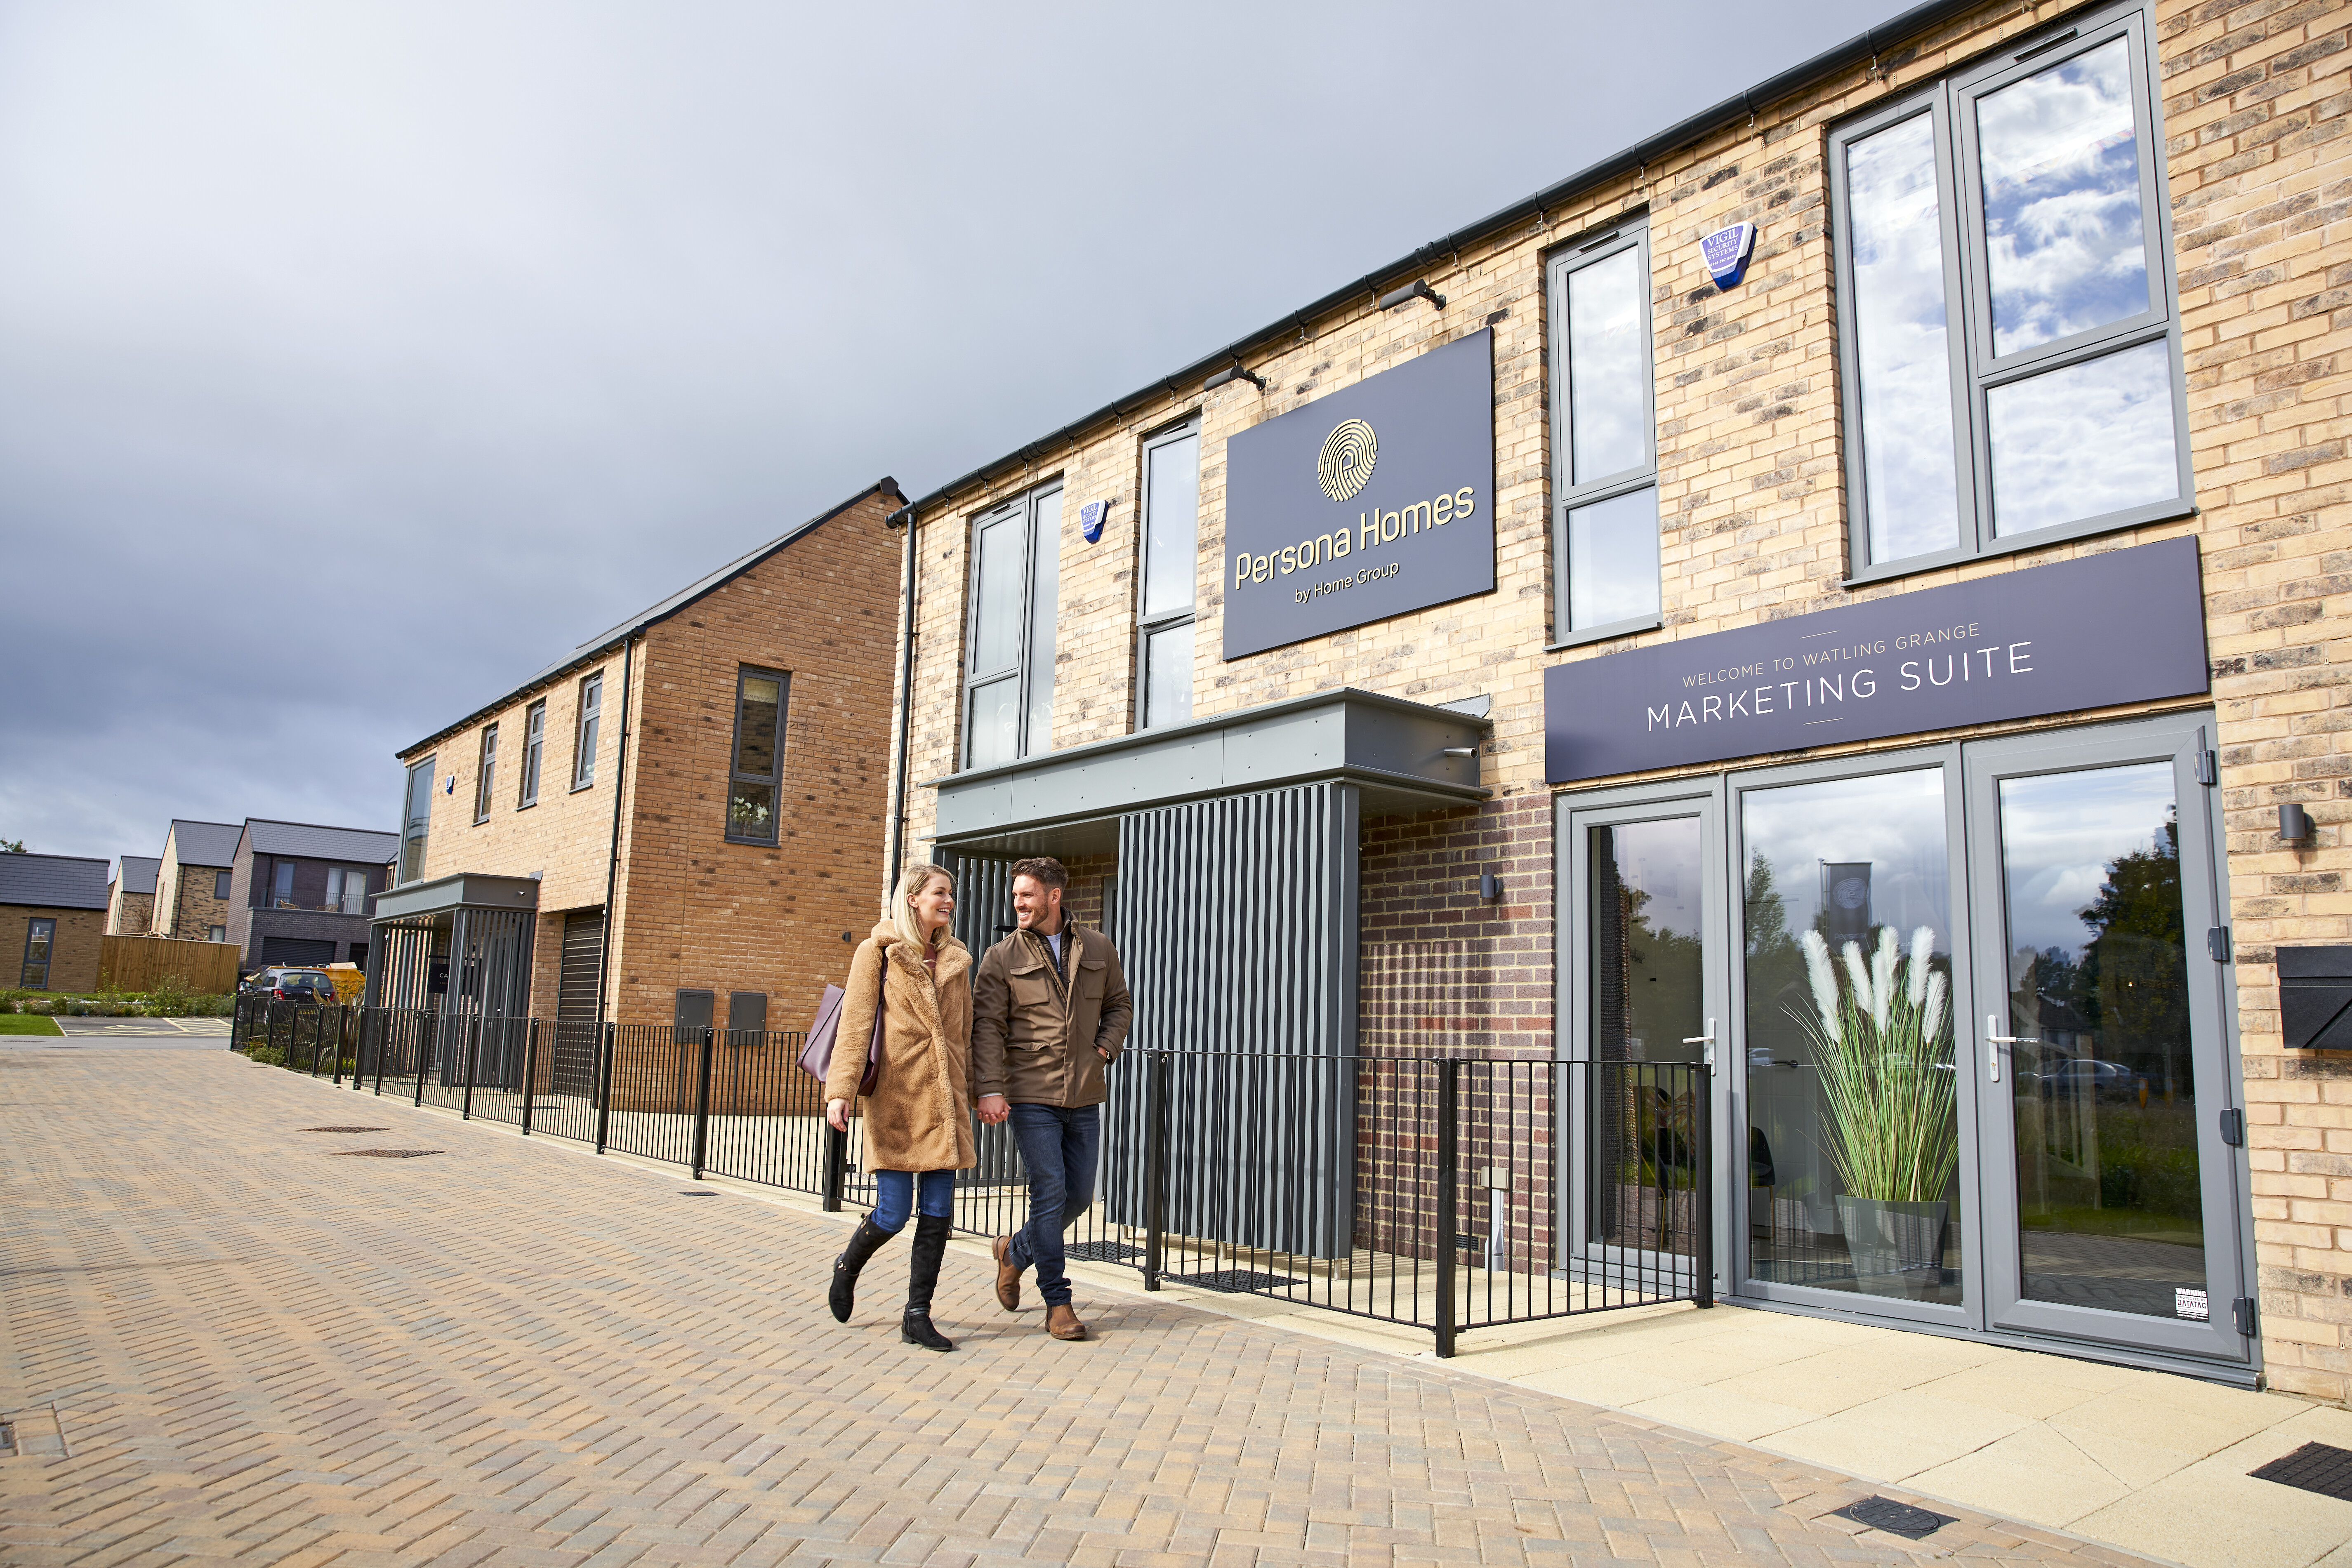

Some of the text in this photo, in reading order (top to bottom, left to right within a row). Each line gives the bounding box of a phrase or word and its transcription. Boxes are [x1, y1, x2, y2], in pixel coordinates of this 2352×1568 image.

[1707, 228, 1739, 247] VIGIL
[1707, 238, 1737, 255] SECURITY
[1708, 245, 1738, 261] SYSTEMS
[1082, 510, 1096, 520] SECURITY
[1083, 504, 1097, 515] VIGIL
[1082, 515, 1096, 524] SYSTEMS
[1236, 487, 1475, 591] Persona Homes
[1295, 562, 1400, 604] by Home Group
[1682, 622, 1980, 688] WELCOME TO WATLING GRANGE
[1648, 641, 2034, 732] MARKETING SUITE
[2175, 1287, 2207, 1298] WARNING
[2178, 1299, 2206, 1309] DATATAG
